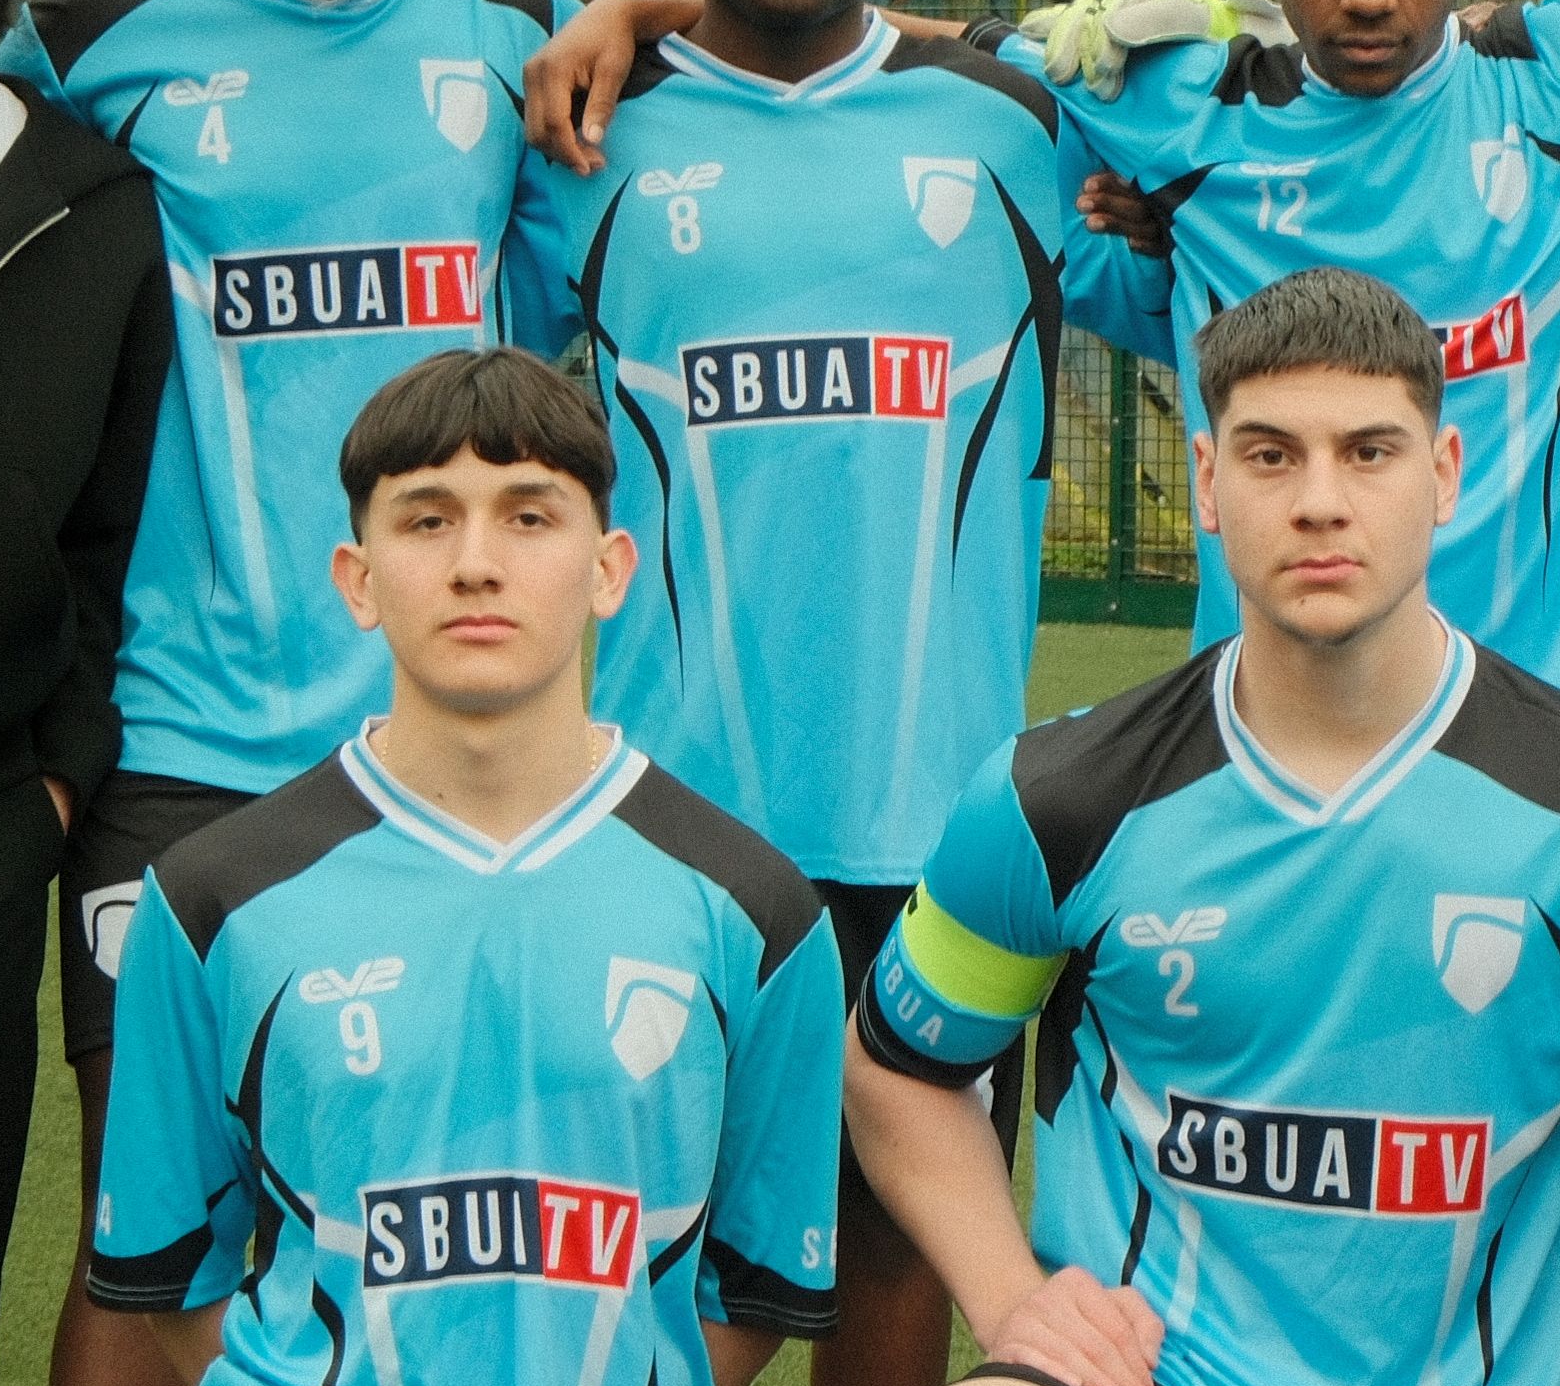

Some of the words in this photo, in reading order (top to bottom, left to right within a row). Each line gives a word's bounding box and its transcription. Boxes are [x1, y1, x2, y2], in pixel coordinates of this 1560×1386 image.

[198, 105, 231, 164] 4
[667, 196, 701, 254] 8
[1254, 178, 1308, 236] 12
[224, 258, 387, 330] SBUA
[414, 254, 480, 317] TV
[693, 347, 854, 417] SBUA
[883, 346, 944, 411] TV
[882, 935, 944, 1047] SBUA
[1158, 948, 1199, 1016] 2
[338, 1001, 383, 1075] 9
[1168, 1109, 1351, 1200] SBUA
[1391, 1131, 1478, 1205] TV
[544, 1192, 631, 1277] TV
